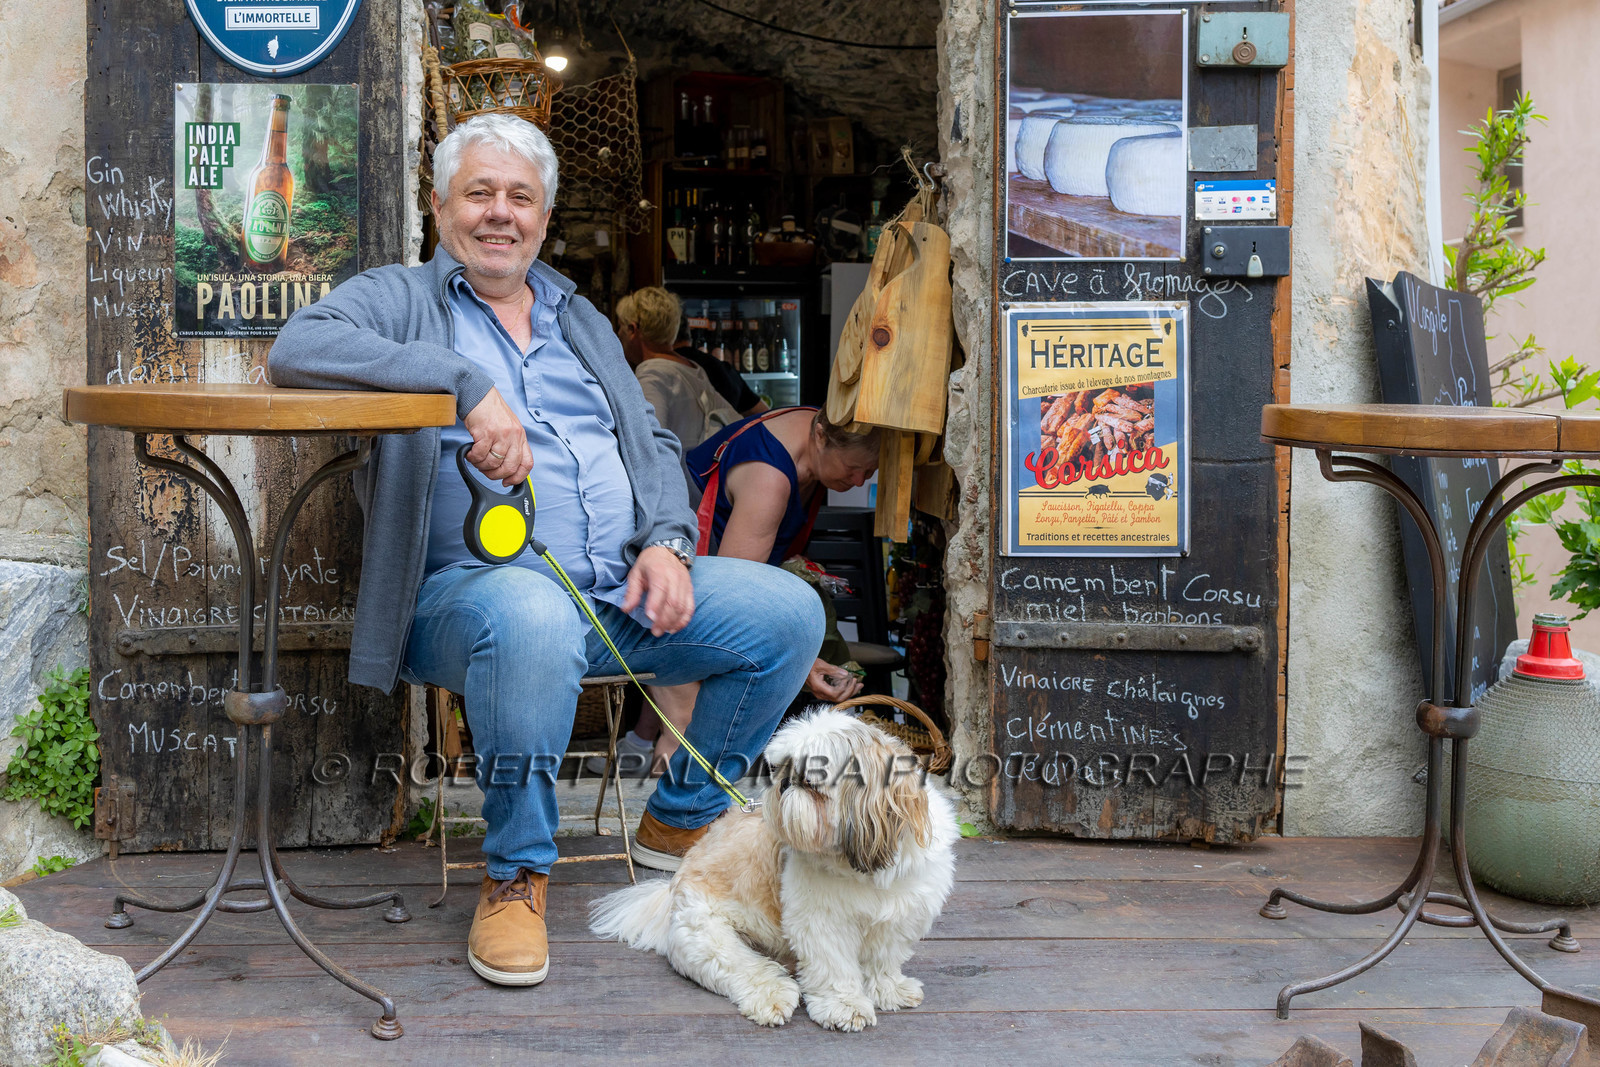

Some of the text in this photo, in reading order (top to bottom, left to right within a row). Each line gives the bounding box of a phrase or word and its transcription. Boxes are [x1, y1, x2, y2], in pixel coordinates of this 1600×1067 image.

[234, 12, 311, 24] L'IMMORTELLE
[188, 124, 236, 145] INDIA
[188, 145, 229, 166] PALE
[86, 155, 125, 185] Gin
[188, 166, 218, 186] ALE
[257, 273, 288, 282] STORIA,
[1122, 262, 1254, 319] fromages
[1030, 336, 1165, 369] HÉRITAGE
[1021, 382, 1059, 397] Charcuterie
[1059, 382, 1076, 392] issue
[1076, 379, 1085, 389] de
[1114, 375, 1123, 384] de
[1123, 374, 1136, 384] nos
[1136, 369, 1172, 382] montagnes
[1024, 439, 1170, 490] Corsica
[1101, 512, 1119, 523] Pâté
[1120, 513, 1128, 523] et
[1129, 512, 1162, 527] Jambon
[1127, 500, 1155, 514] Coppa
[1026, 532, 1170, 542] Traditions et recettes ancestrales
[1001, 563, 1176, 600] Camembert
[1026, 594, 1223, 625] miel bonbons
[129, 721, 237, 758] MUSCAT
[1004, 750, 1123, 788] Cédrats
